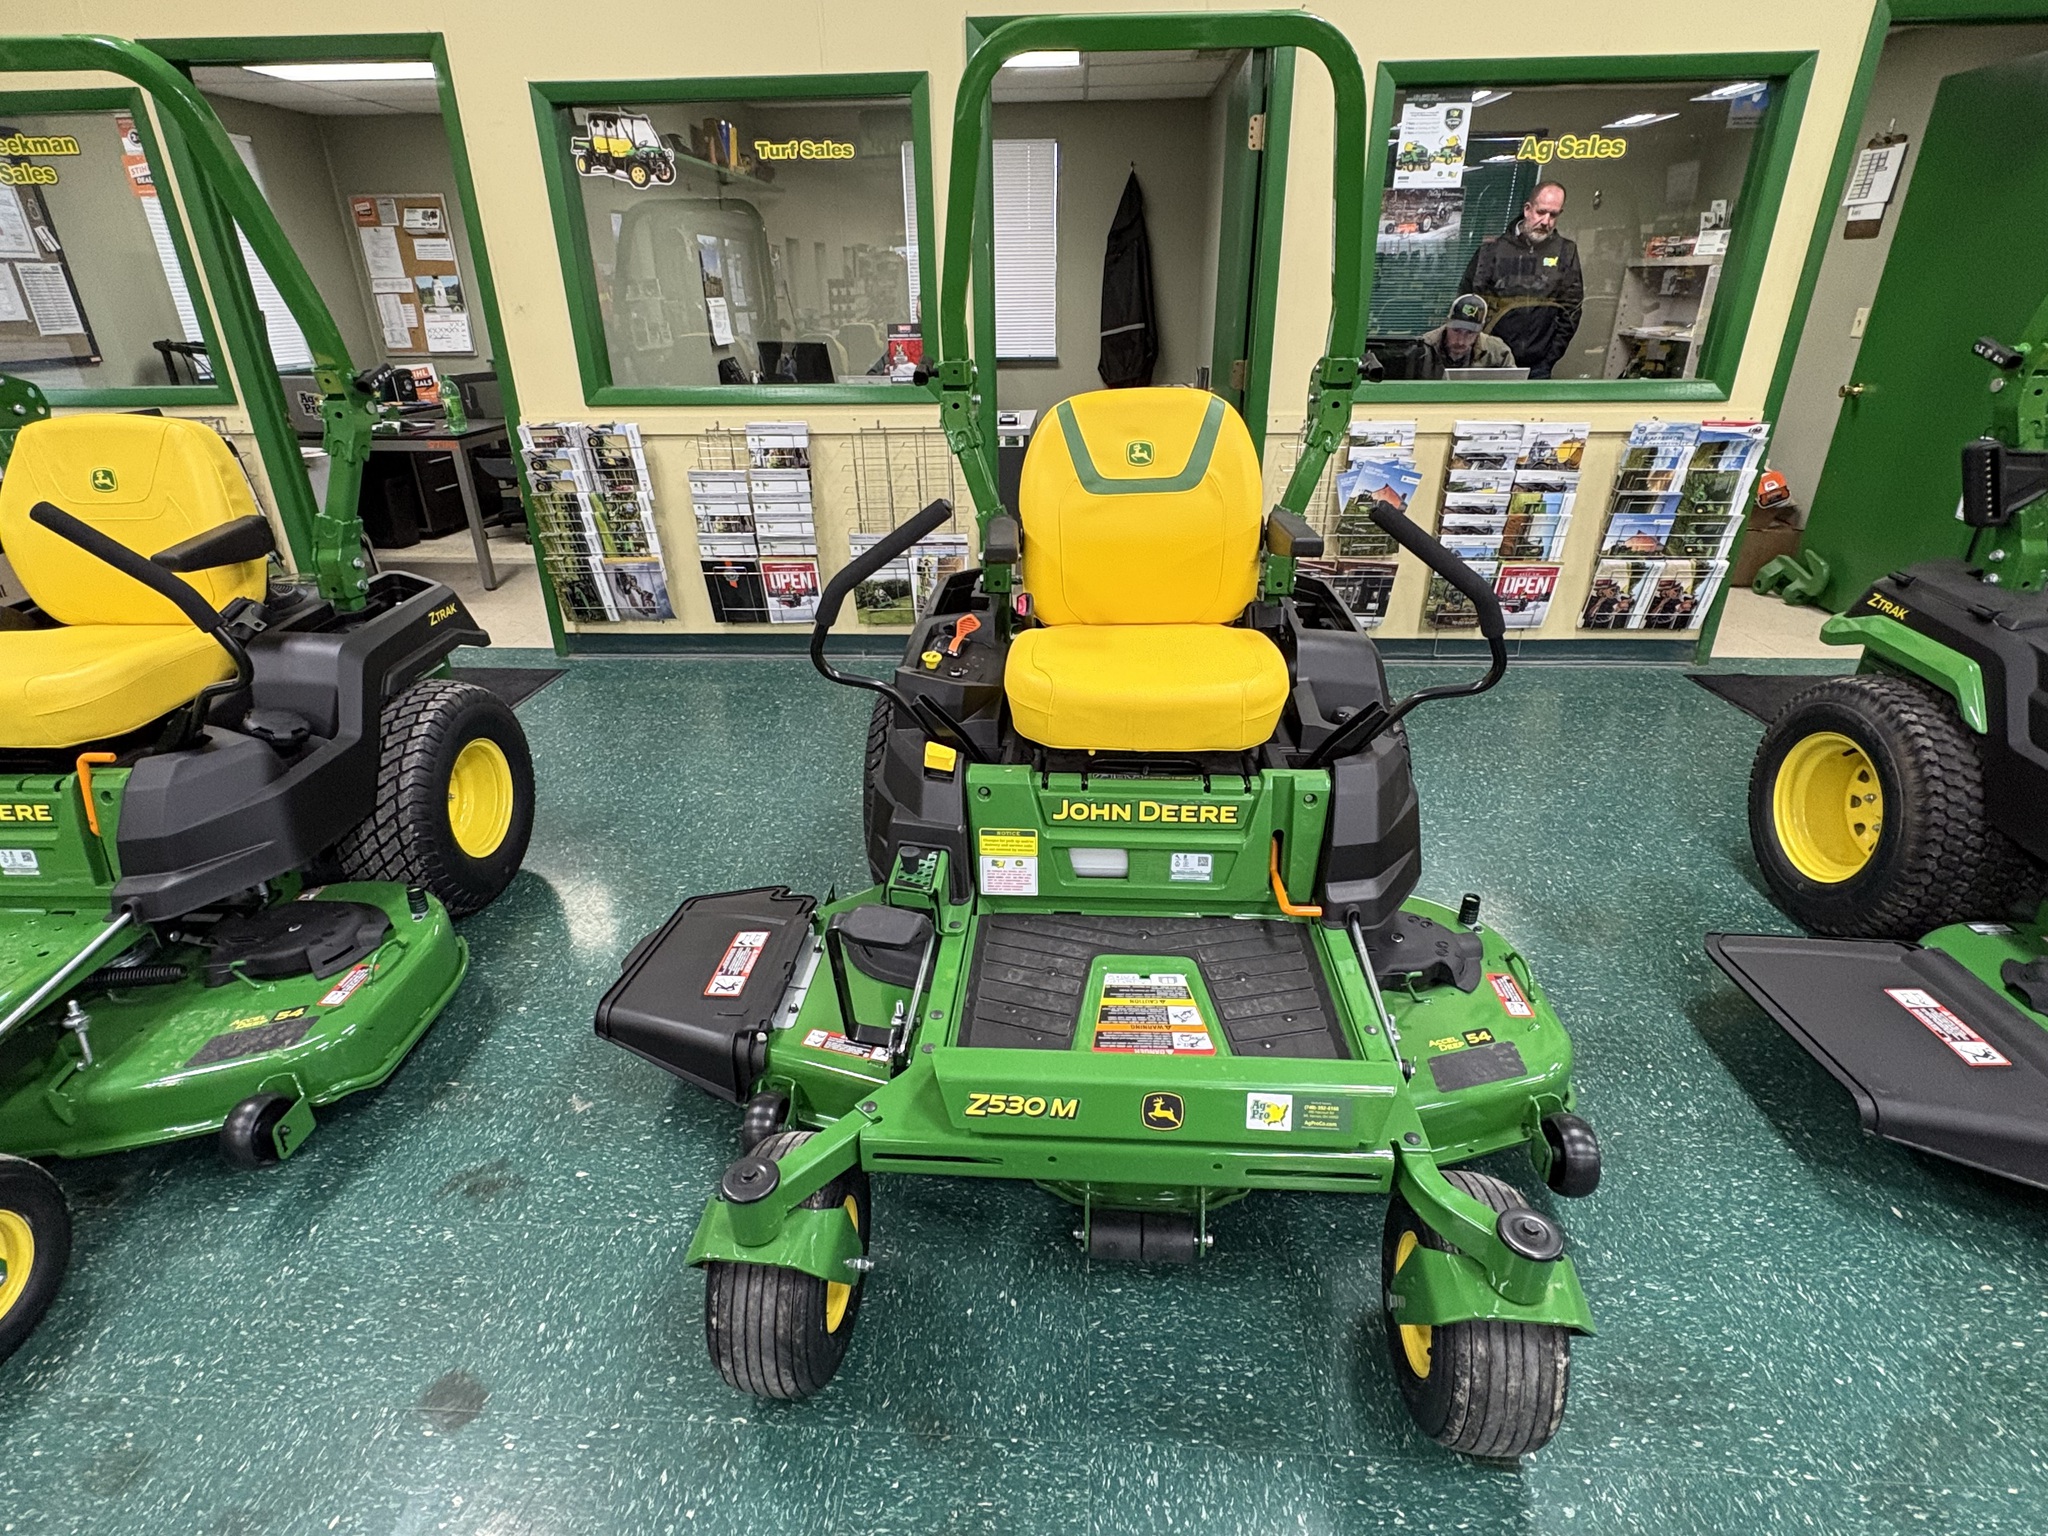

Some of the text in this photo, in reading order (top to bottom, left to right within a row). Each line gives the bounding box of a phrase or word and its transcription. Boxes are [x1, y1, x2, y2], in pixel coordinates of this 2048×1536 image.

[0, 133, 81, 156] eekman
[755, 140, 855, 159] Turf Sales
[1517, 134, 1626, 164] Ag Sales
[0, 162, 58, 185] Sales
[130, 166, 148, 176] STIH
[414, 378, 433, 388] EALS
[1502, 576, 1549, 594] OPEN
[428, 602, 458, 627] ZTRAK
[1866, 592, 1910, 620] ZTRAK
[0, 804, 53, 821] ERE
[1052, 799, 1238, 824] JOHN DEERE
[274, 1007, 305, 1021] 54
[1465, 1031, 1492, 1044] 54
[965, 1093, 1080, 1119] Z530 M
[1250, 1110, 1271, 1120] Pro
